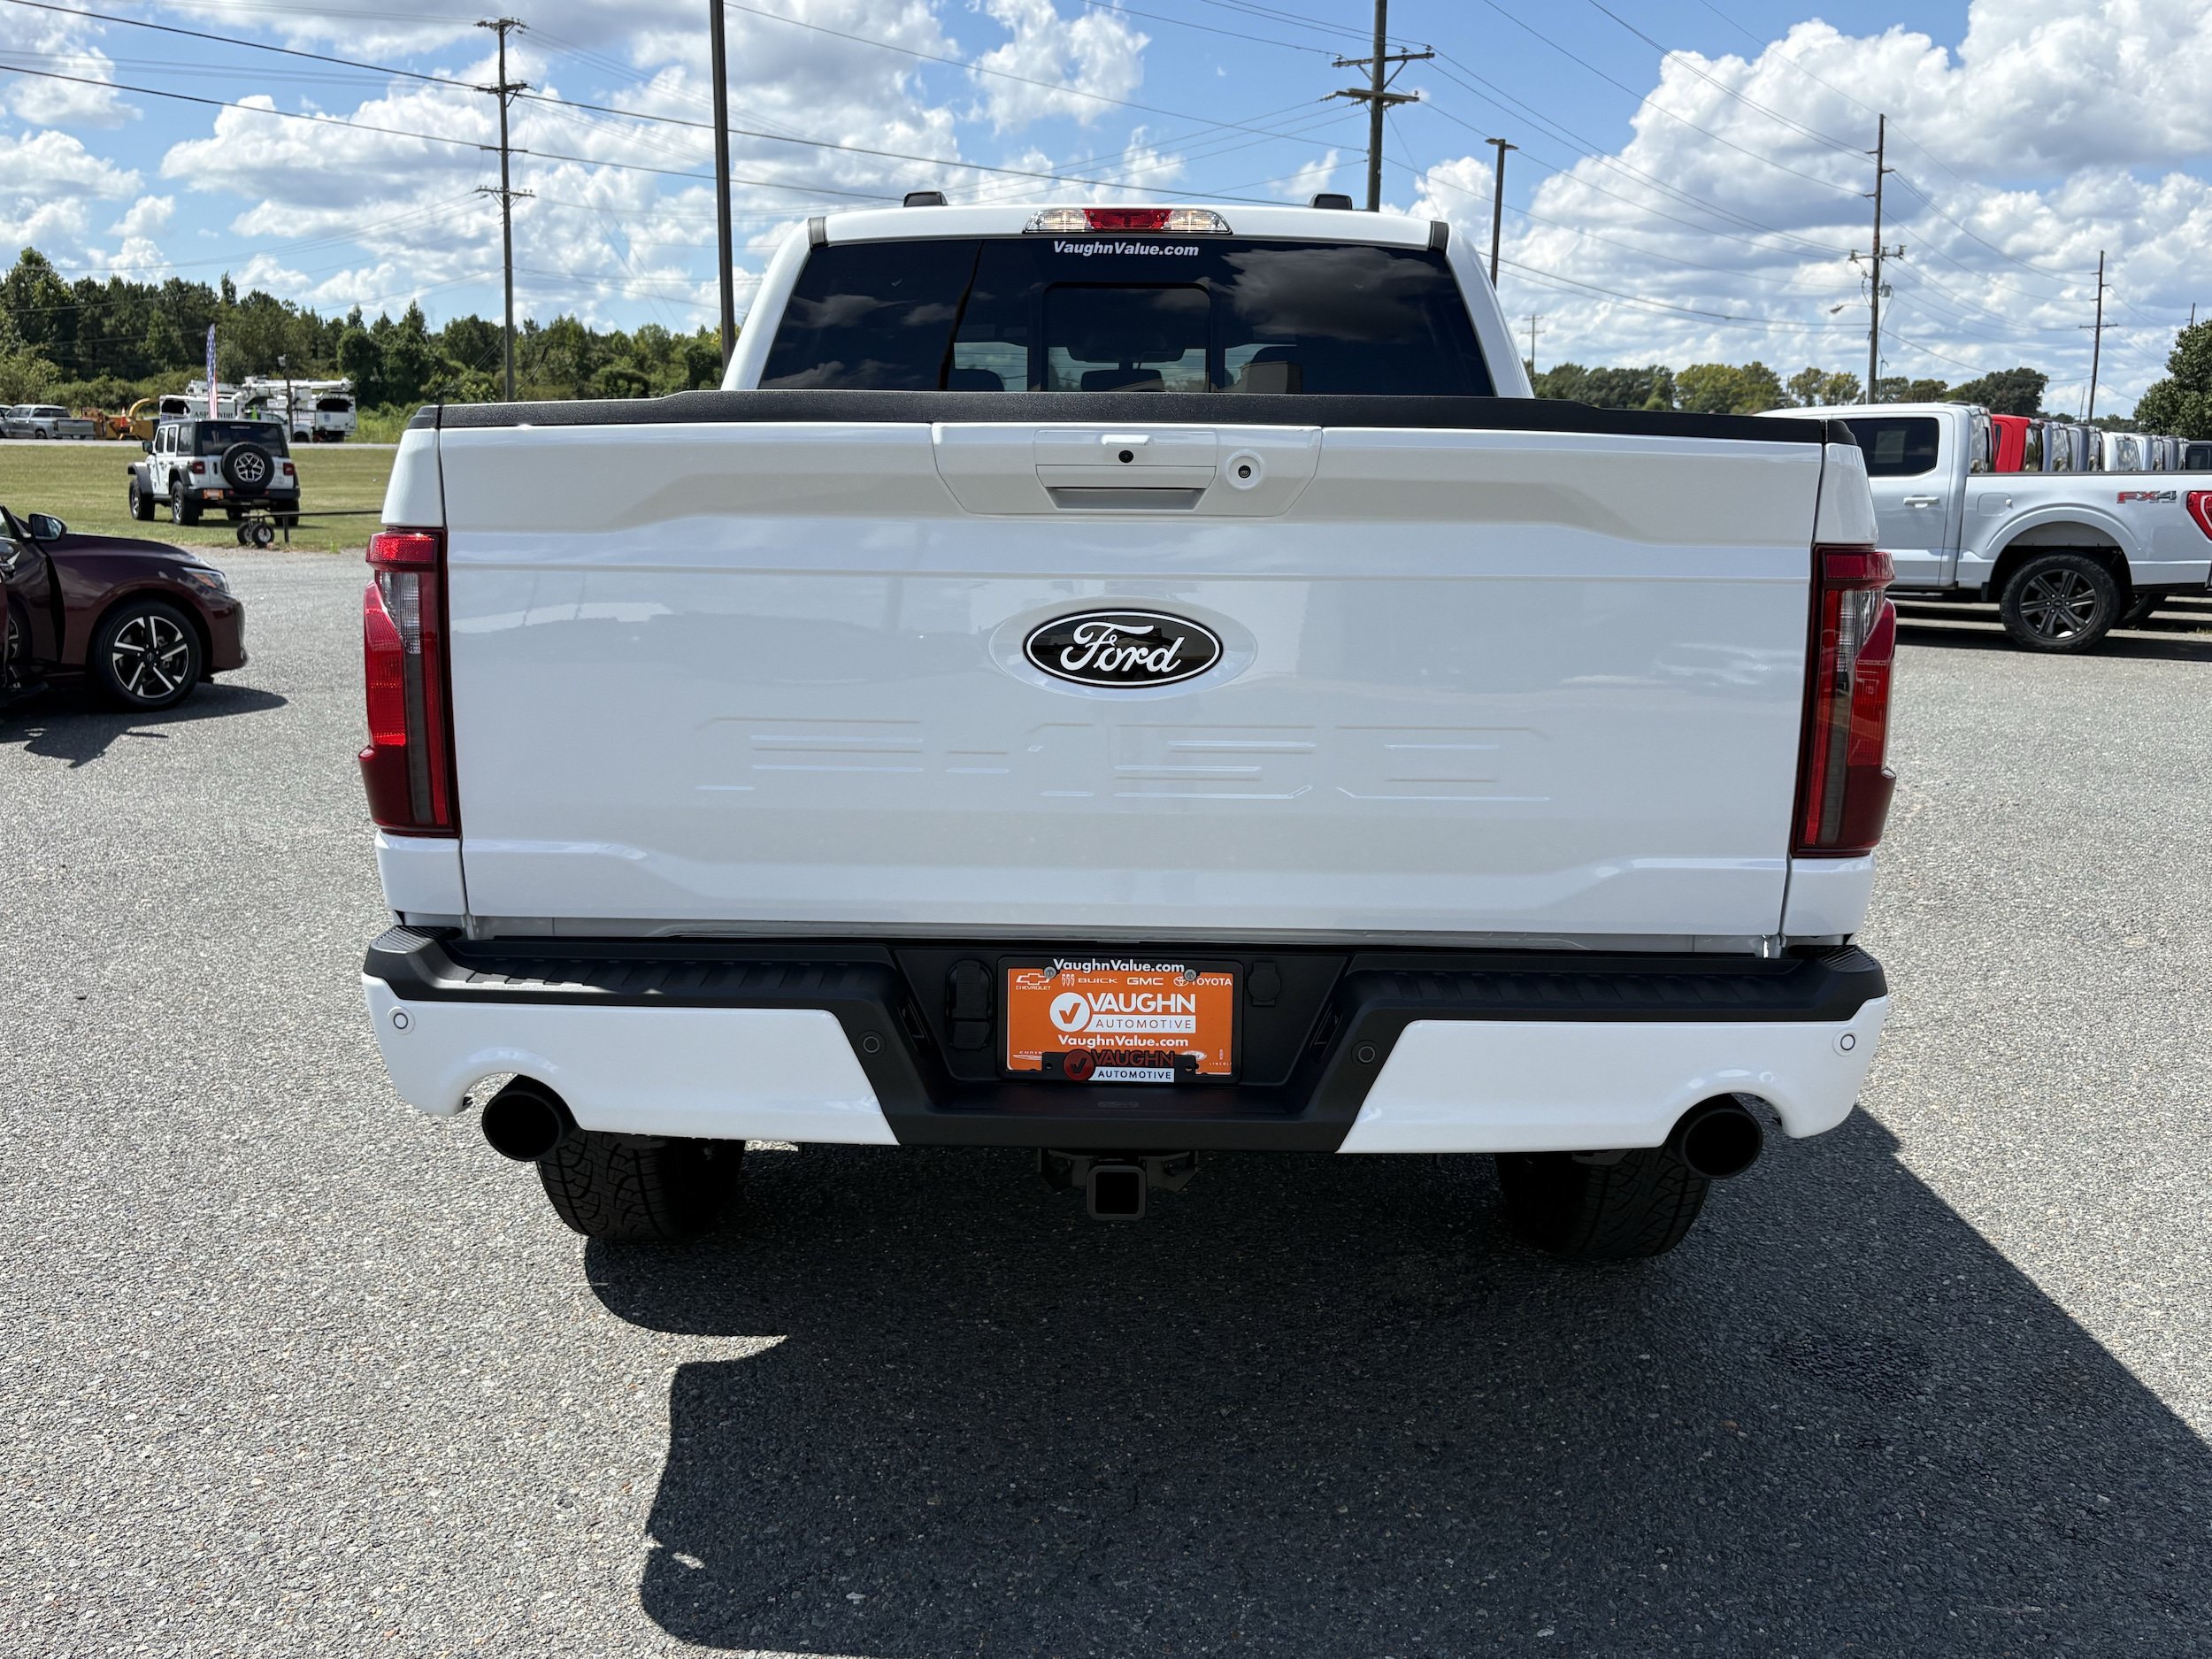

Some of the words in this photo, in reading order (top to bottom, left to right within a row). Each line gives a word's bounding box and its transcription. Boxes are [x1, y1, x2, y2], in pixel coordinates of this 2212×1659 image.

[1053, 241, 1199, 257] VaughnValue.com
[2116, 490, 2177, 504] FX4
[1060, 621, 1185, 672] Ford
[1053, 958, 1185, 974] VaughnValue.com
[1126, 977, 1164, 986] GMC
[1087, 992, 1196, 1013] VAUGHN
[1095, 1018, 1192, 1029] AUTOMOTIVE
[1057, 1034, 1189, 1048] VaughnValue.com
[1090, 1049, 1175, 1067] VAUGHN
[1097, 1070, 1171, 1079] AUTOMOTIVE
